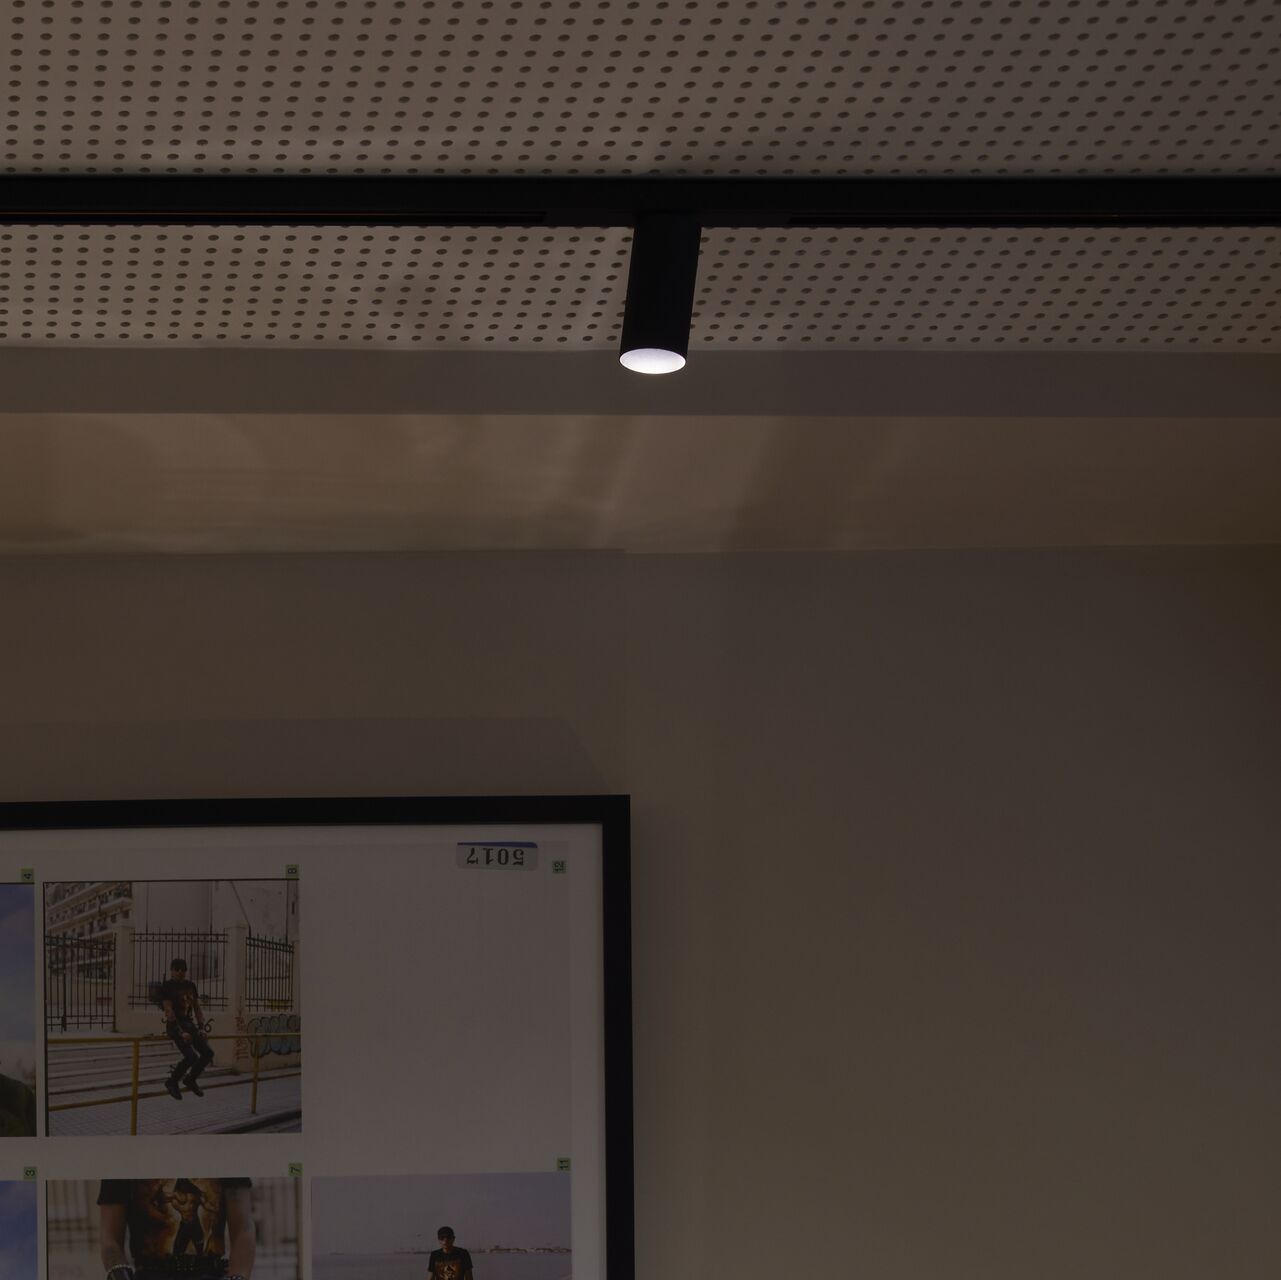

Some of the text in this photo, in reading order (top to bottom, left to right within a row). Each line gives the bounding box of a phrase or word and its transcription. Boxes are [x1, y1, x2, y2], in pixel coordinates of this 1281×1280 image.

[466, 847, 525, 866] 5017
[287, 867, 297, 875] 8
[23, 872, 32, 880] 4
[558, 1160, 569, 1168] 11
[25, 1169, 36, 1177] 3
[290, 1166, 302, 1174] 7
